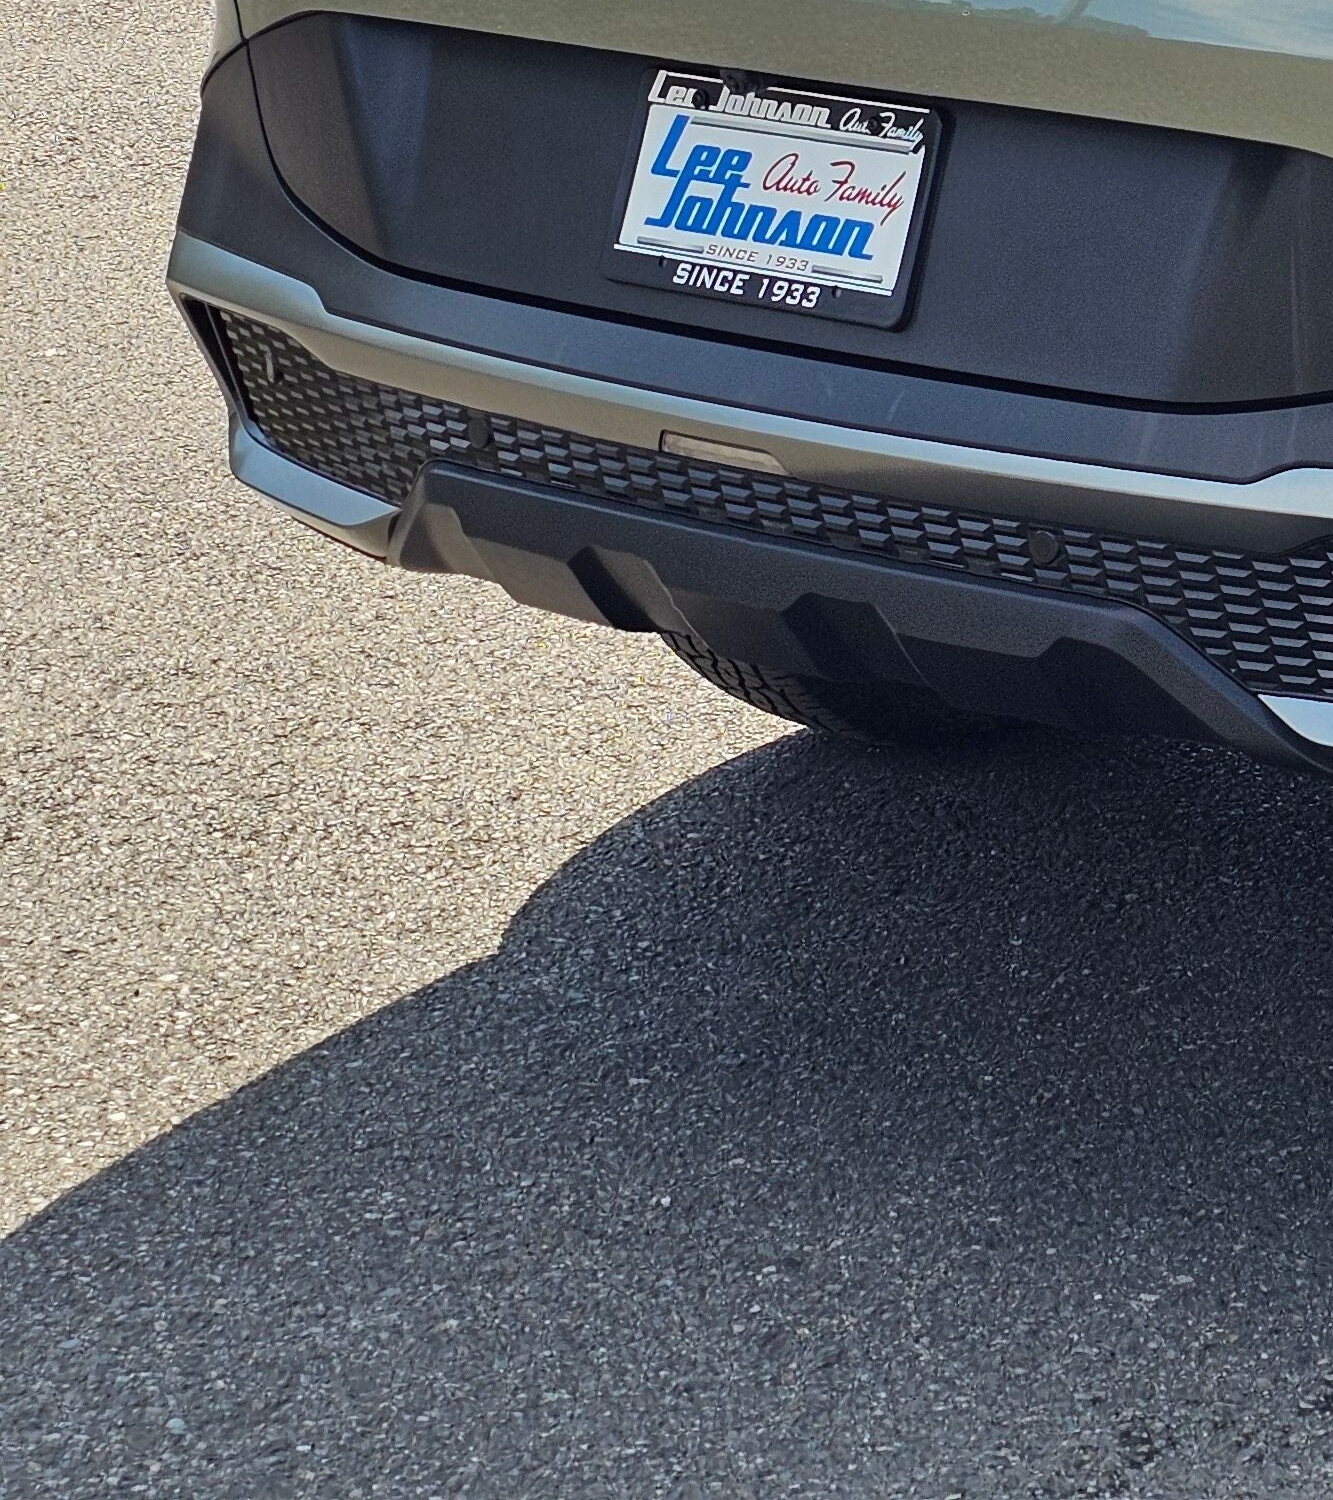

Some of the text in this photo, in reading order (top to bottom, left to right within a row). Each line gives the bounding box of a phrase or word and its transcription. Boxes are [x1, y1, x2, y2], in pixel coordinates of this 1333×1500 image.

[651, 114, 753, 188] Lee
[708, 80, 832, 129] Johnson
[879, 111, 924, 151] Family
[644, 172, 874, 261] Johnson
[762, 152, 905, 227] Auto Family
[672, 263, 822, 309] SINCE 1933
[706, 244, 809, 274] SINCE 1933
